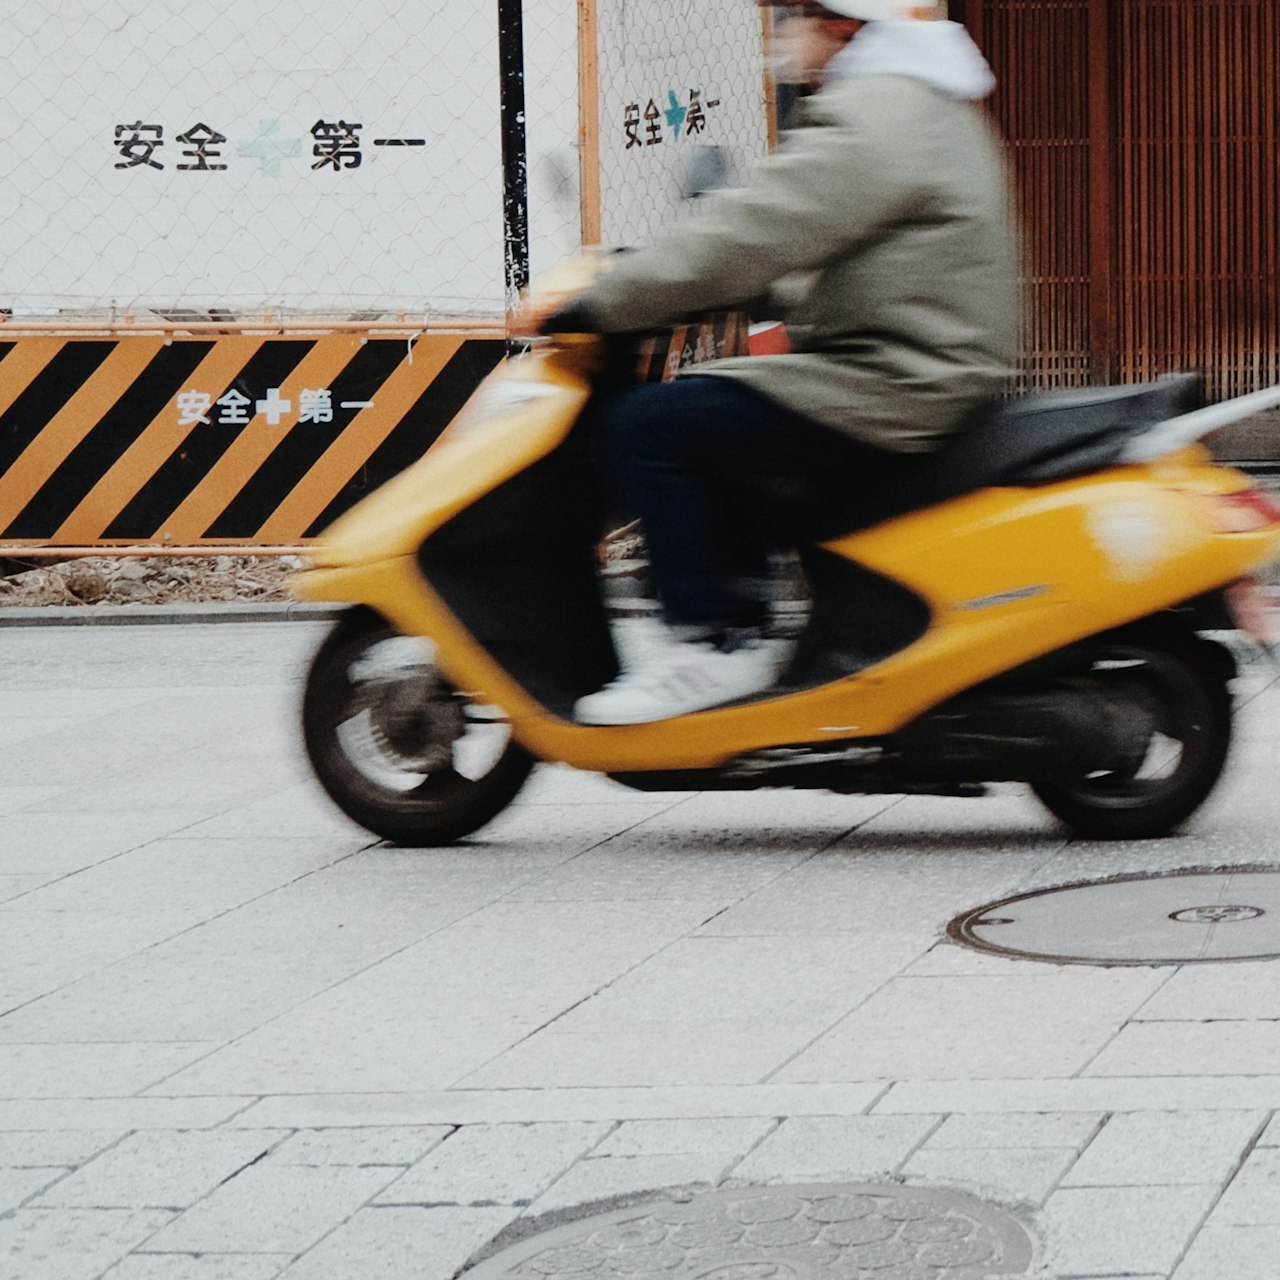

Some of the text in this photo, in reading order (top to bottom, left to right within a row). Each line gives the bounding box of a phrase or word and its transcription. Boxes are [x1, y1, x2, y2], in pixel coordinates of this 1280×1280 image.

[113, 120, 426, 171] 安全 第一
[176, 388, 375, 426] 安全 第一
